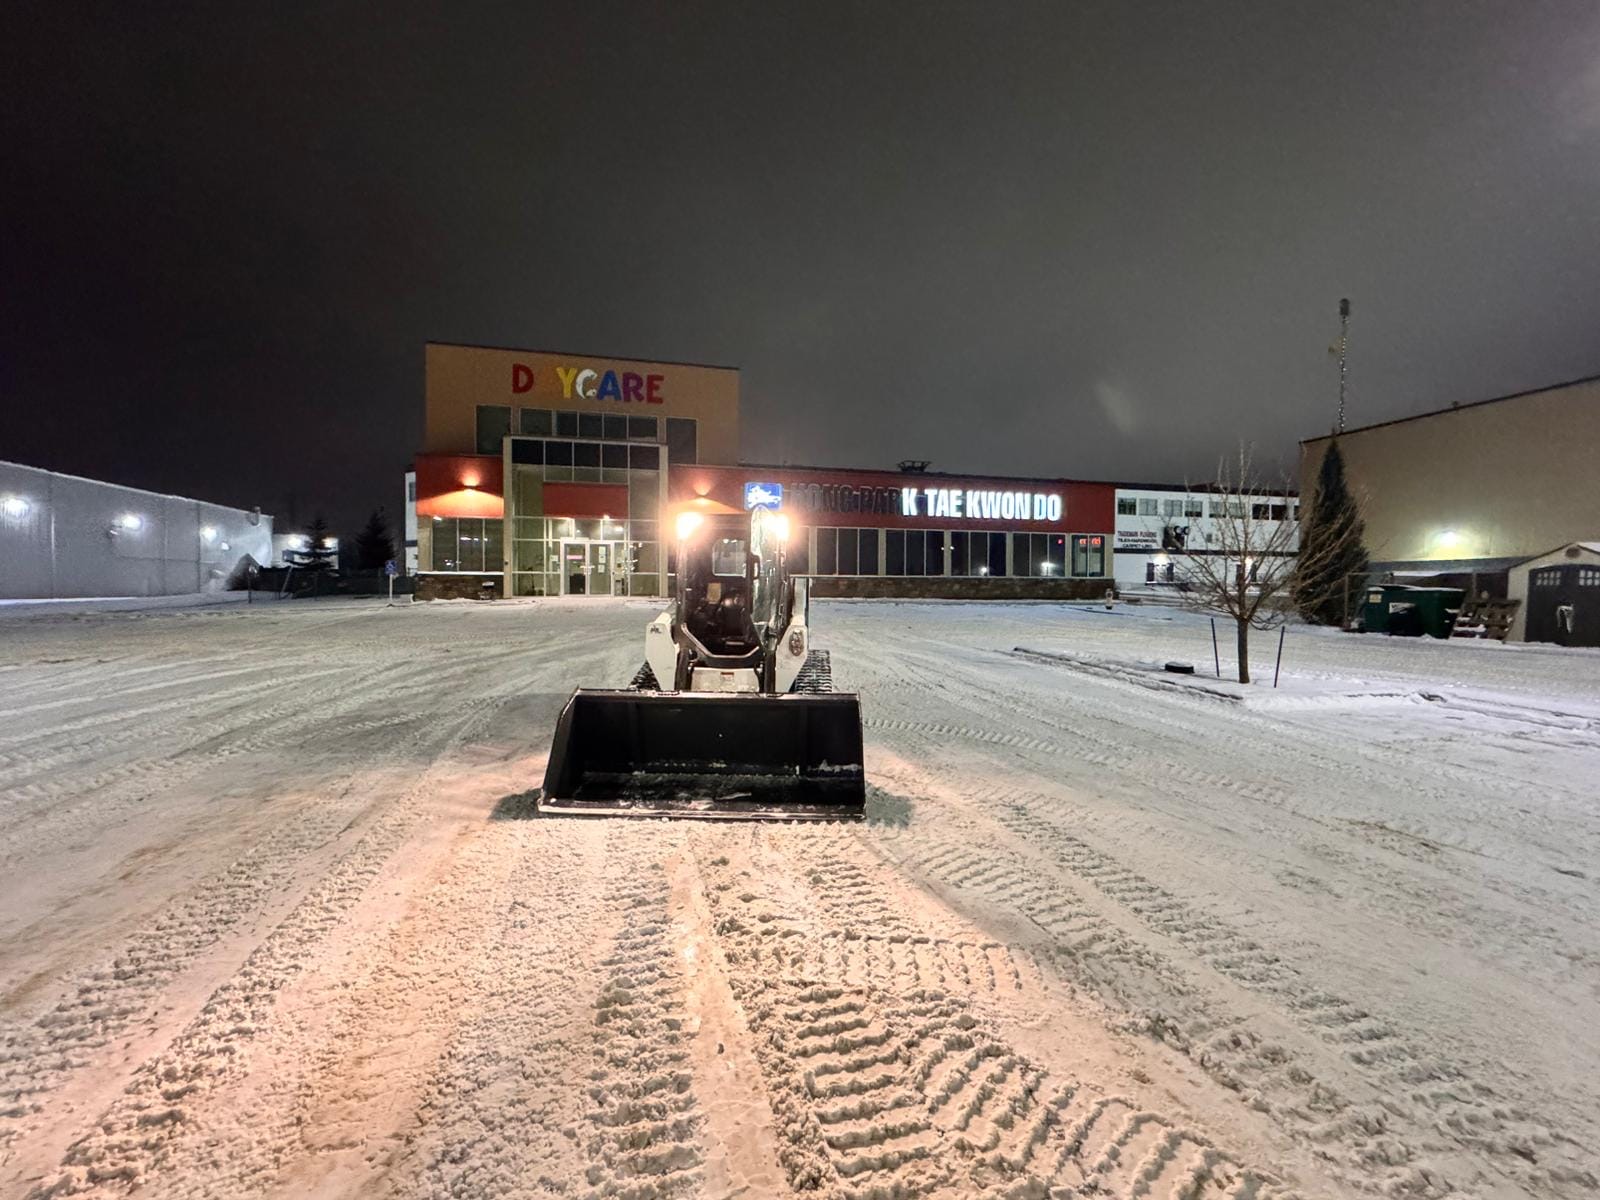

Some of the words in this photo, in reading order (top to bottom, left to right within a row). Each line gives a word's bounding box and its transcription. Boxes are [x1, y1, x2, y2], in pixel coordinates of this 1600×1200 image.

[859, 485, 918, 516] PARK
[924, 488, 963, 518] TAE
[966, 490, 1031, 520] KWON
[1034, 494, 1062, 522] DO
